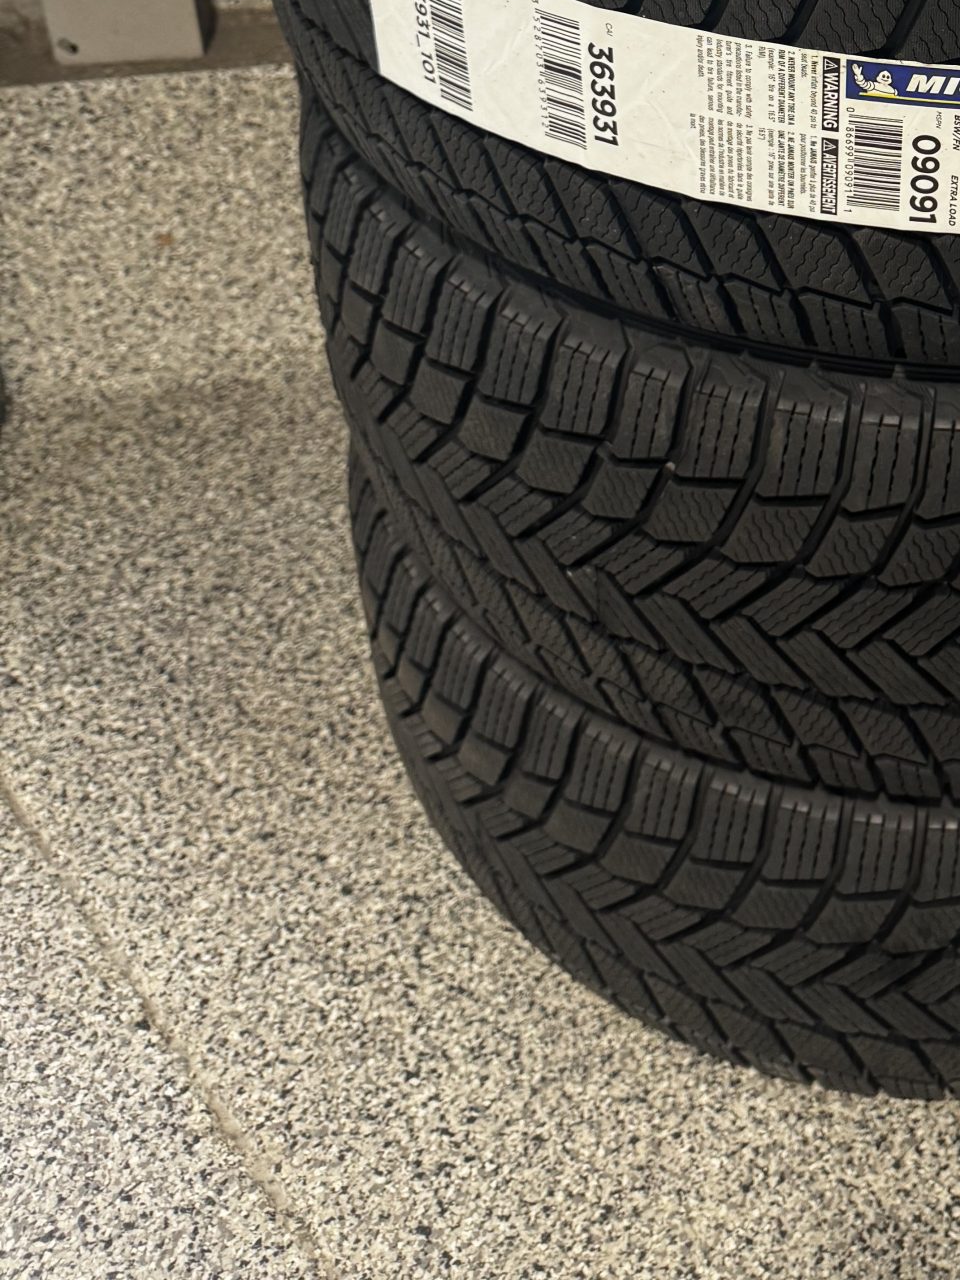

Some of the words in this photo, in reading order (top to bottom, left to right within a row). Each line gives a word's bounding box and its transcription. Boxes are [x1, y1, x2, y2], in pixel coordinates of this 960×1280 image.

[588, 42, 619, 147] 363931
[823, 72, 839, 129] WARNING
[845, 127, 854, 157] 86699
[822, 152, 837, 214] AVERTISSEMENT
[844, 164, 853, 193] 09091
[909, 134, 941, 224] 09091
[950, 175, 959, 201] EXTRA
[949, 203, 957, 227] LOAD
